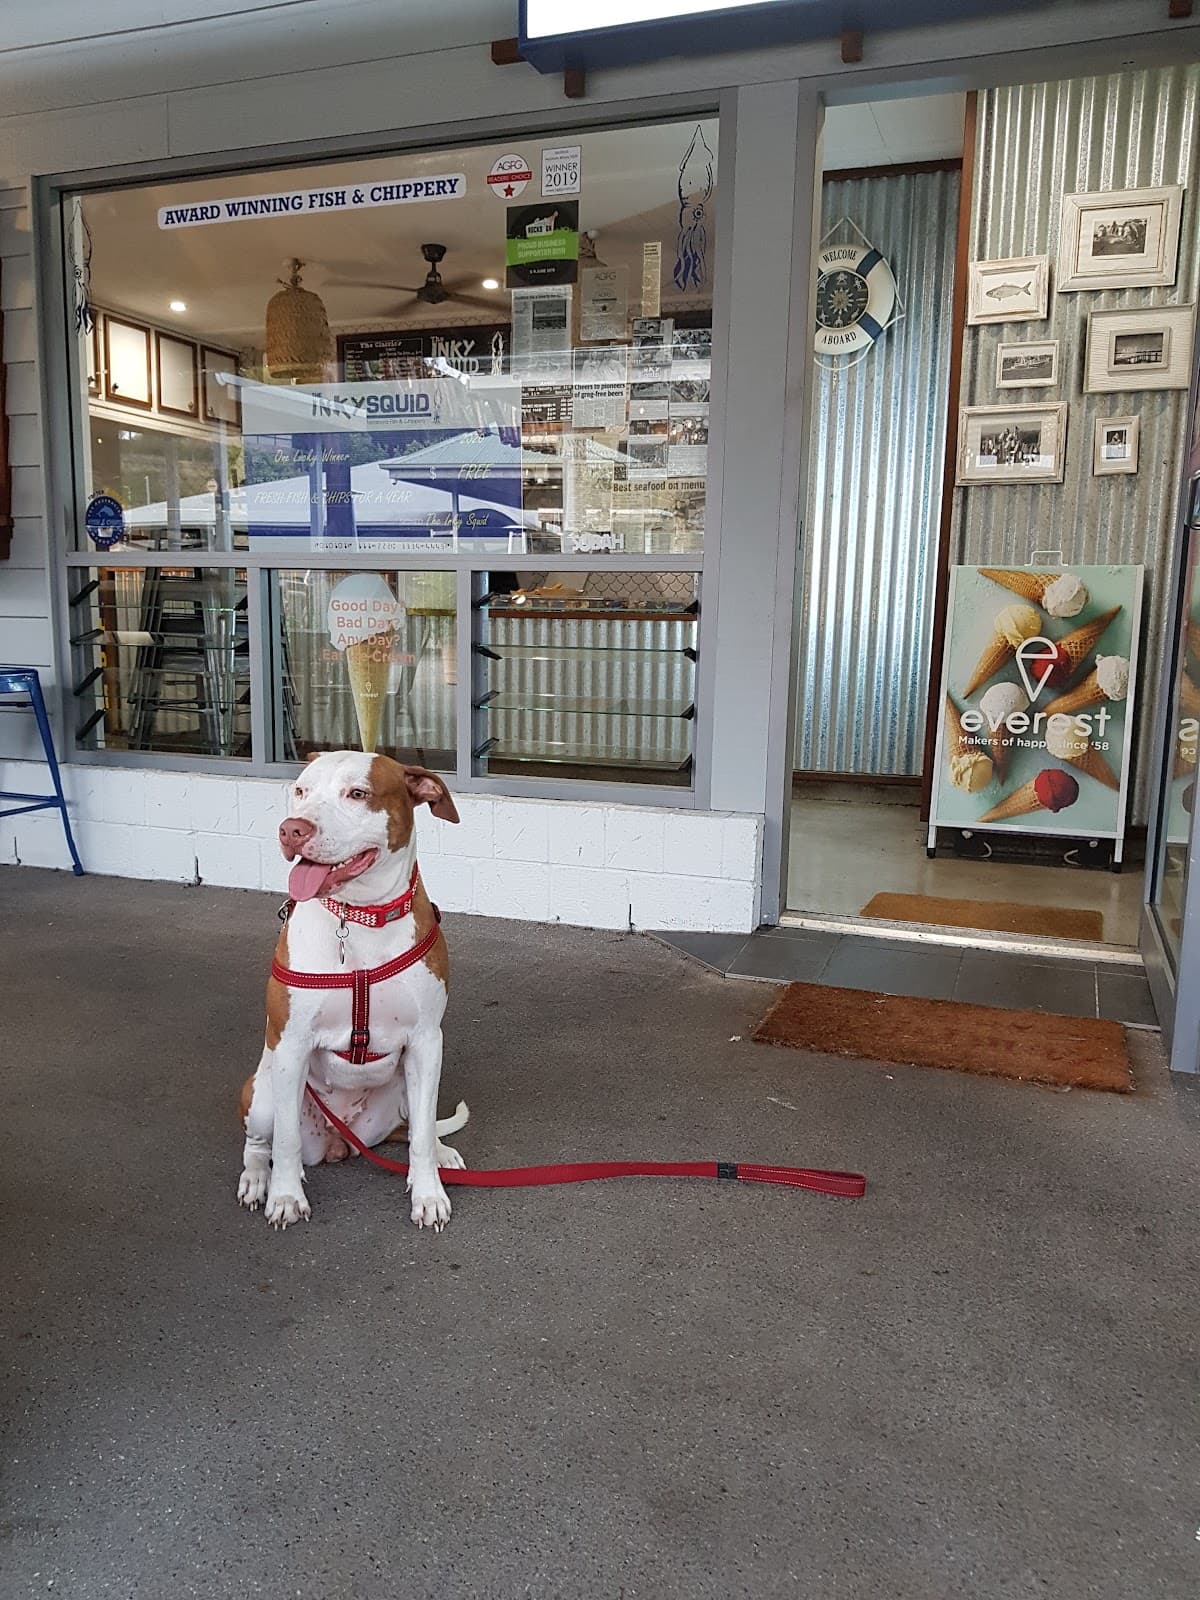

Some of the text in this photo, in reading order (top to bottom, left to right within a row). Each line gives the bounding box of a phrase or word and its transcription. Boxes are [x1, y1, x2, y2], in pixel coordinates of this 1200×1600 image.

[497, 160, 523, 171] AGFG
[545, 162, 578, 173] WINNER
[545, 171, 578, 188] 2019
[164, 178, 460, 225] AWARD WINNING FISH & CHIPPERY
[518, 248, 552, 258] SUPPORTER
[822, 249, 858, 263] WELCOME
[821, 331, 857, 345] ABOARD
[432, 339, 476, 358] INKY
[575, 383, 593, 391] Cheers
[601, 382, 626, 391] pioneers
[366, 393, 430, 413] SQUID
[274, 447, 350, 466] One Lucky Winner
[458, 463, 494, 480] FREE
[613, 480, 706, 492] Best seafood on menu
[255, 491, 285, 503] FRESH
[285, 491, 308, 503] FISH
[323, 490, 352, 503] CHIPS
[385, 489, 412, 504] YEAR
[425, 512, 438, 526] The
[466, 512, 489, 529] Squid
[331, 600, 367, 612] Good
[337, 617, 400, 631] Bad Day?
[338, 633, 400, 648] Any Day?
[960, 706, 1112, 737] everest
[958, 736, 999, 747] Makers
[1001, 737, 1015, 748] of
